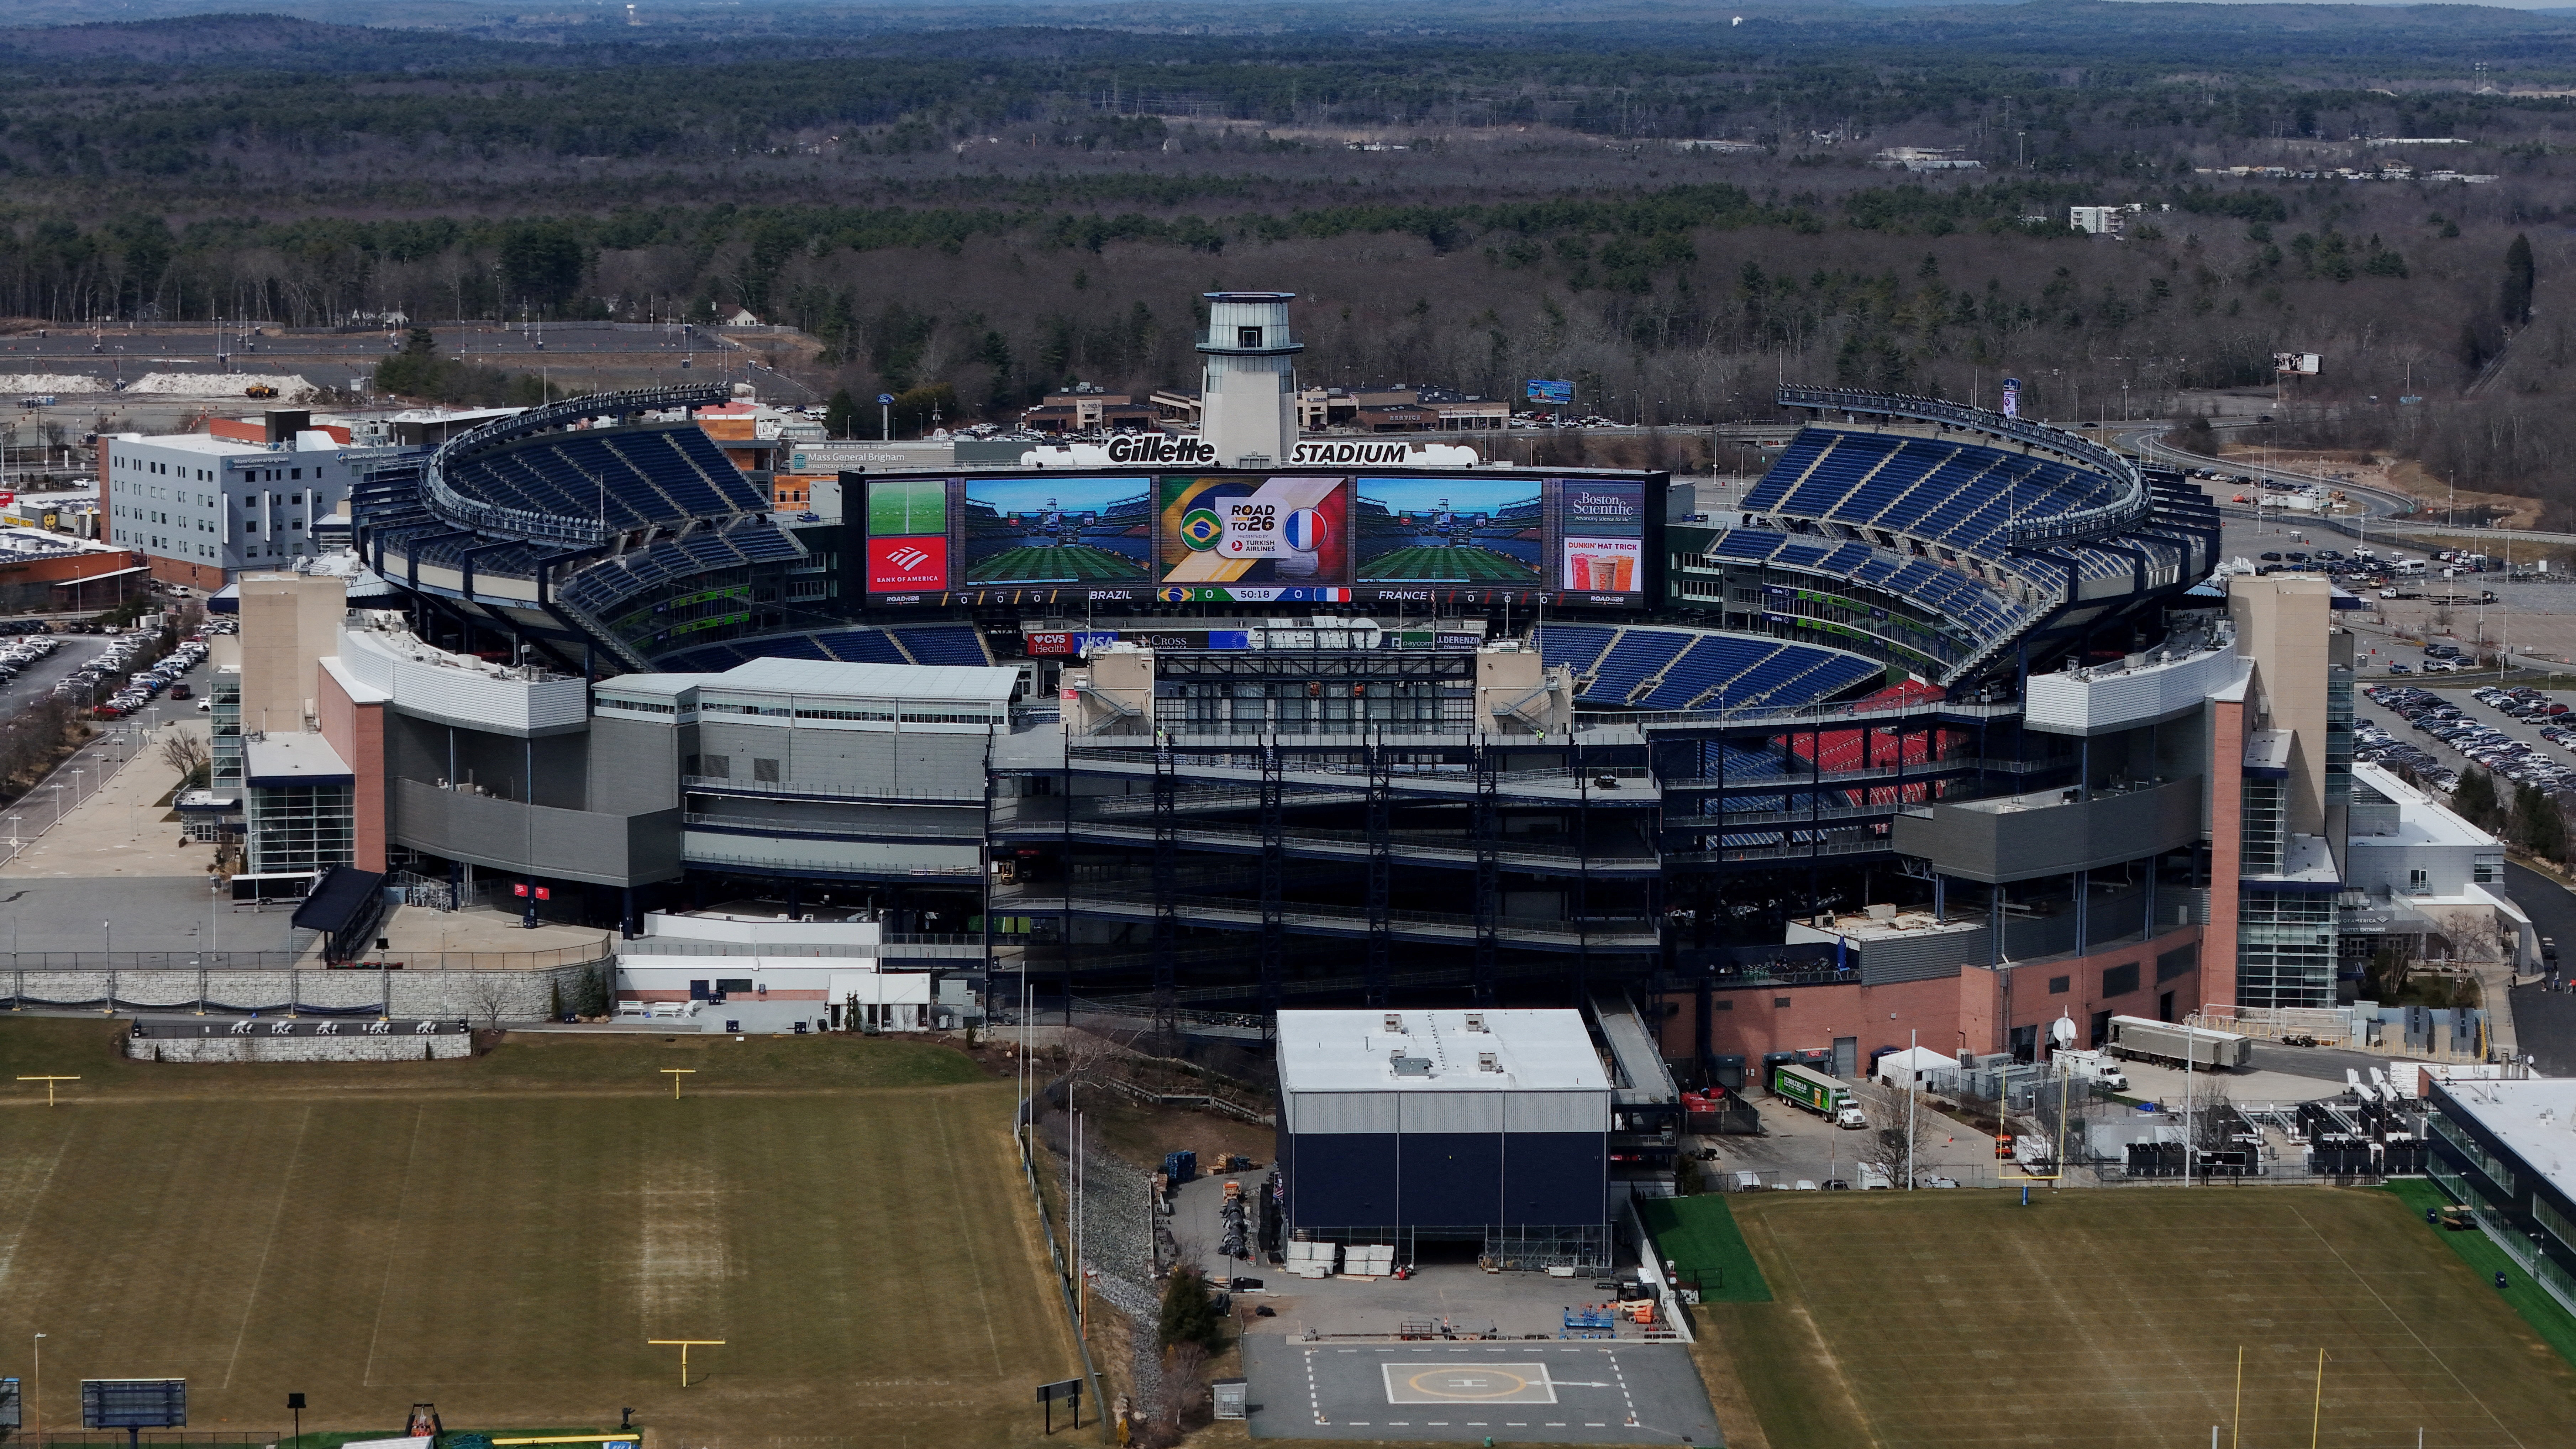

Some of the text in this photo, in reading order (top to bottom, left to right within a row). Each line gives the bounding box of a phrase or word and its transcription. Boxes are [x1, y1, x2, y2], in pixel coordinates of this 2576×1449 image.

[1108, 436, 1215, 462] Gillette
[1293, 444, 1405, 463] STADIUM
[808, 452, 904, 462] Mass General Brigham
[1581, 492, 1619, 505] Boston
[1231, 505, 1275, 516] ROAD
[1573, 500, 1633, 515] Scientific
[1090, 590, 1132, 599] BRAZIL
[1205, 590, 1213, 599] 0
[1294, 589, 1302, 599] 0
[1379, 591, 1428, 600] FRANCE
[1044, 635, 1066, 644] CVS
[1077, 636, 1113, 649] VISA
